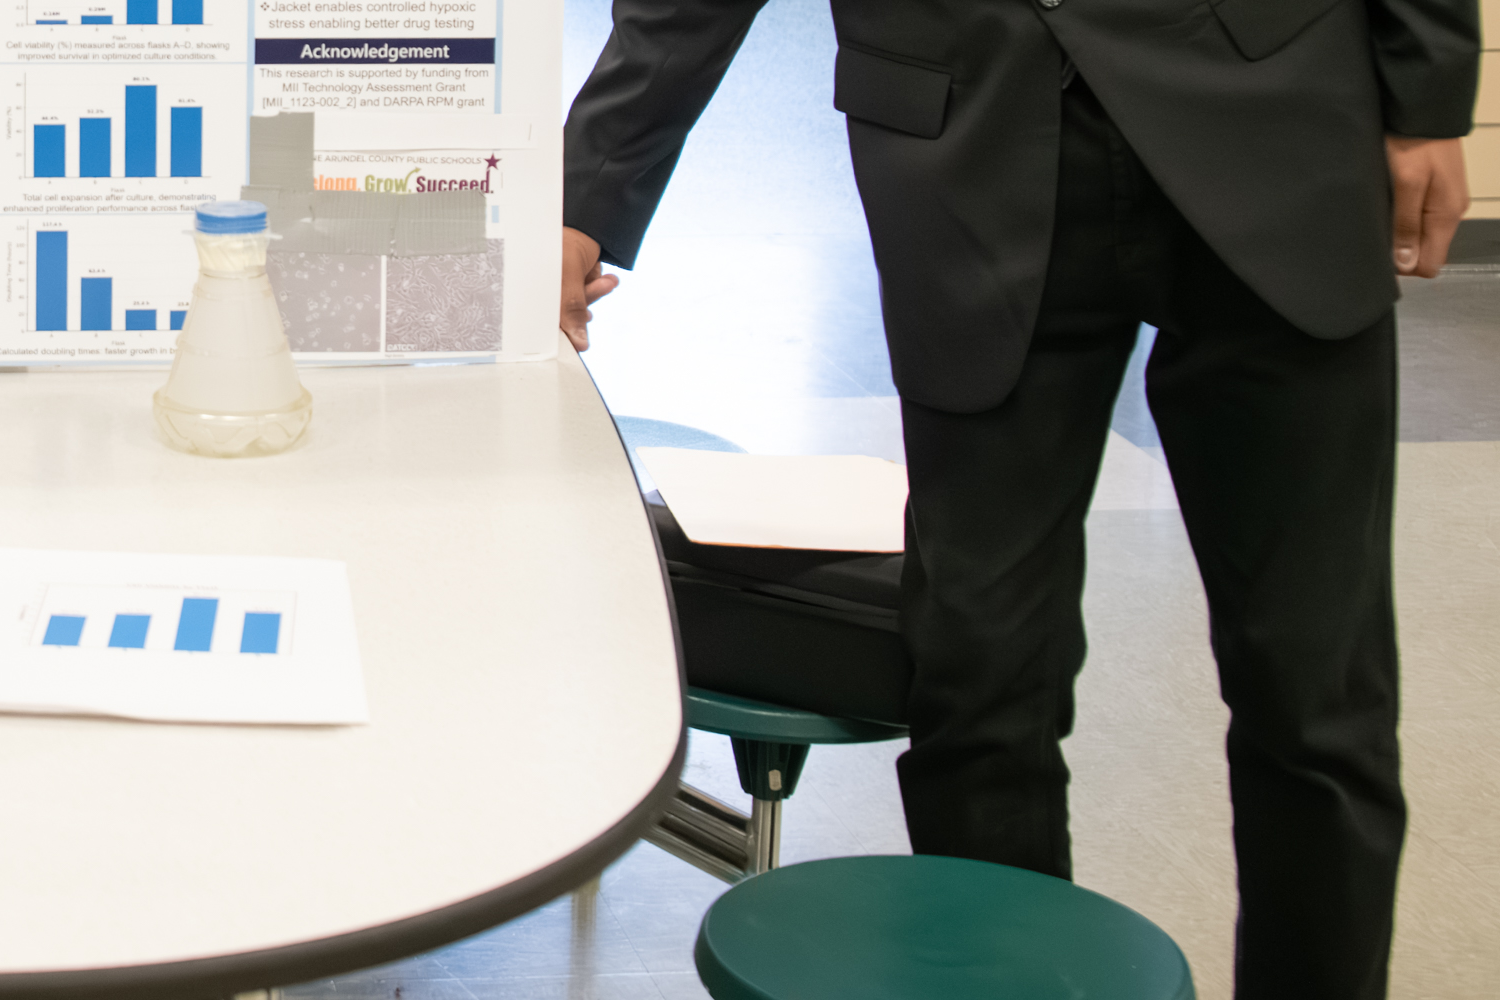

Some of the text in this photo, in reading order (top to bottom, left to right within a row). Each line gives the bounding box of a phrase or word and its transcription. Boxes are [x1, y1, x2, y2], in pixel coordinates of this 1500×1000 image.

[299, 42, 451, 63] Acknowledgement
[259, 67, 490, 81] This research is supported by funding from
[282, 81, 466, 95] MII Technology Assessment Grant
[365, 175, 411, 192] Grow.
[416, 170, 494, 194] Succeed.
